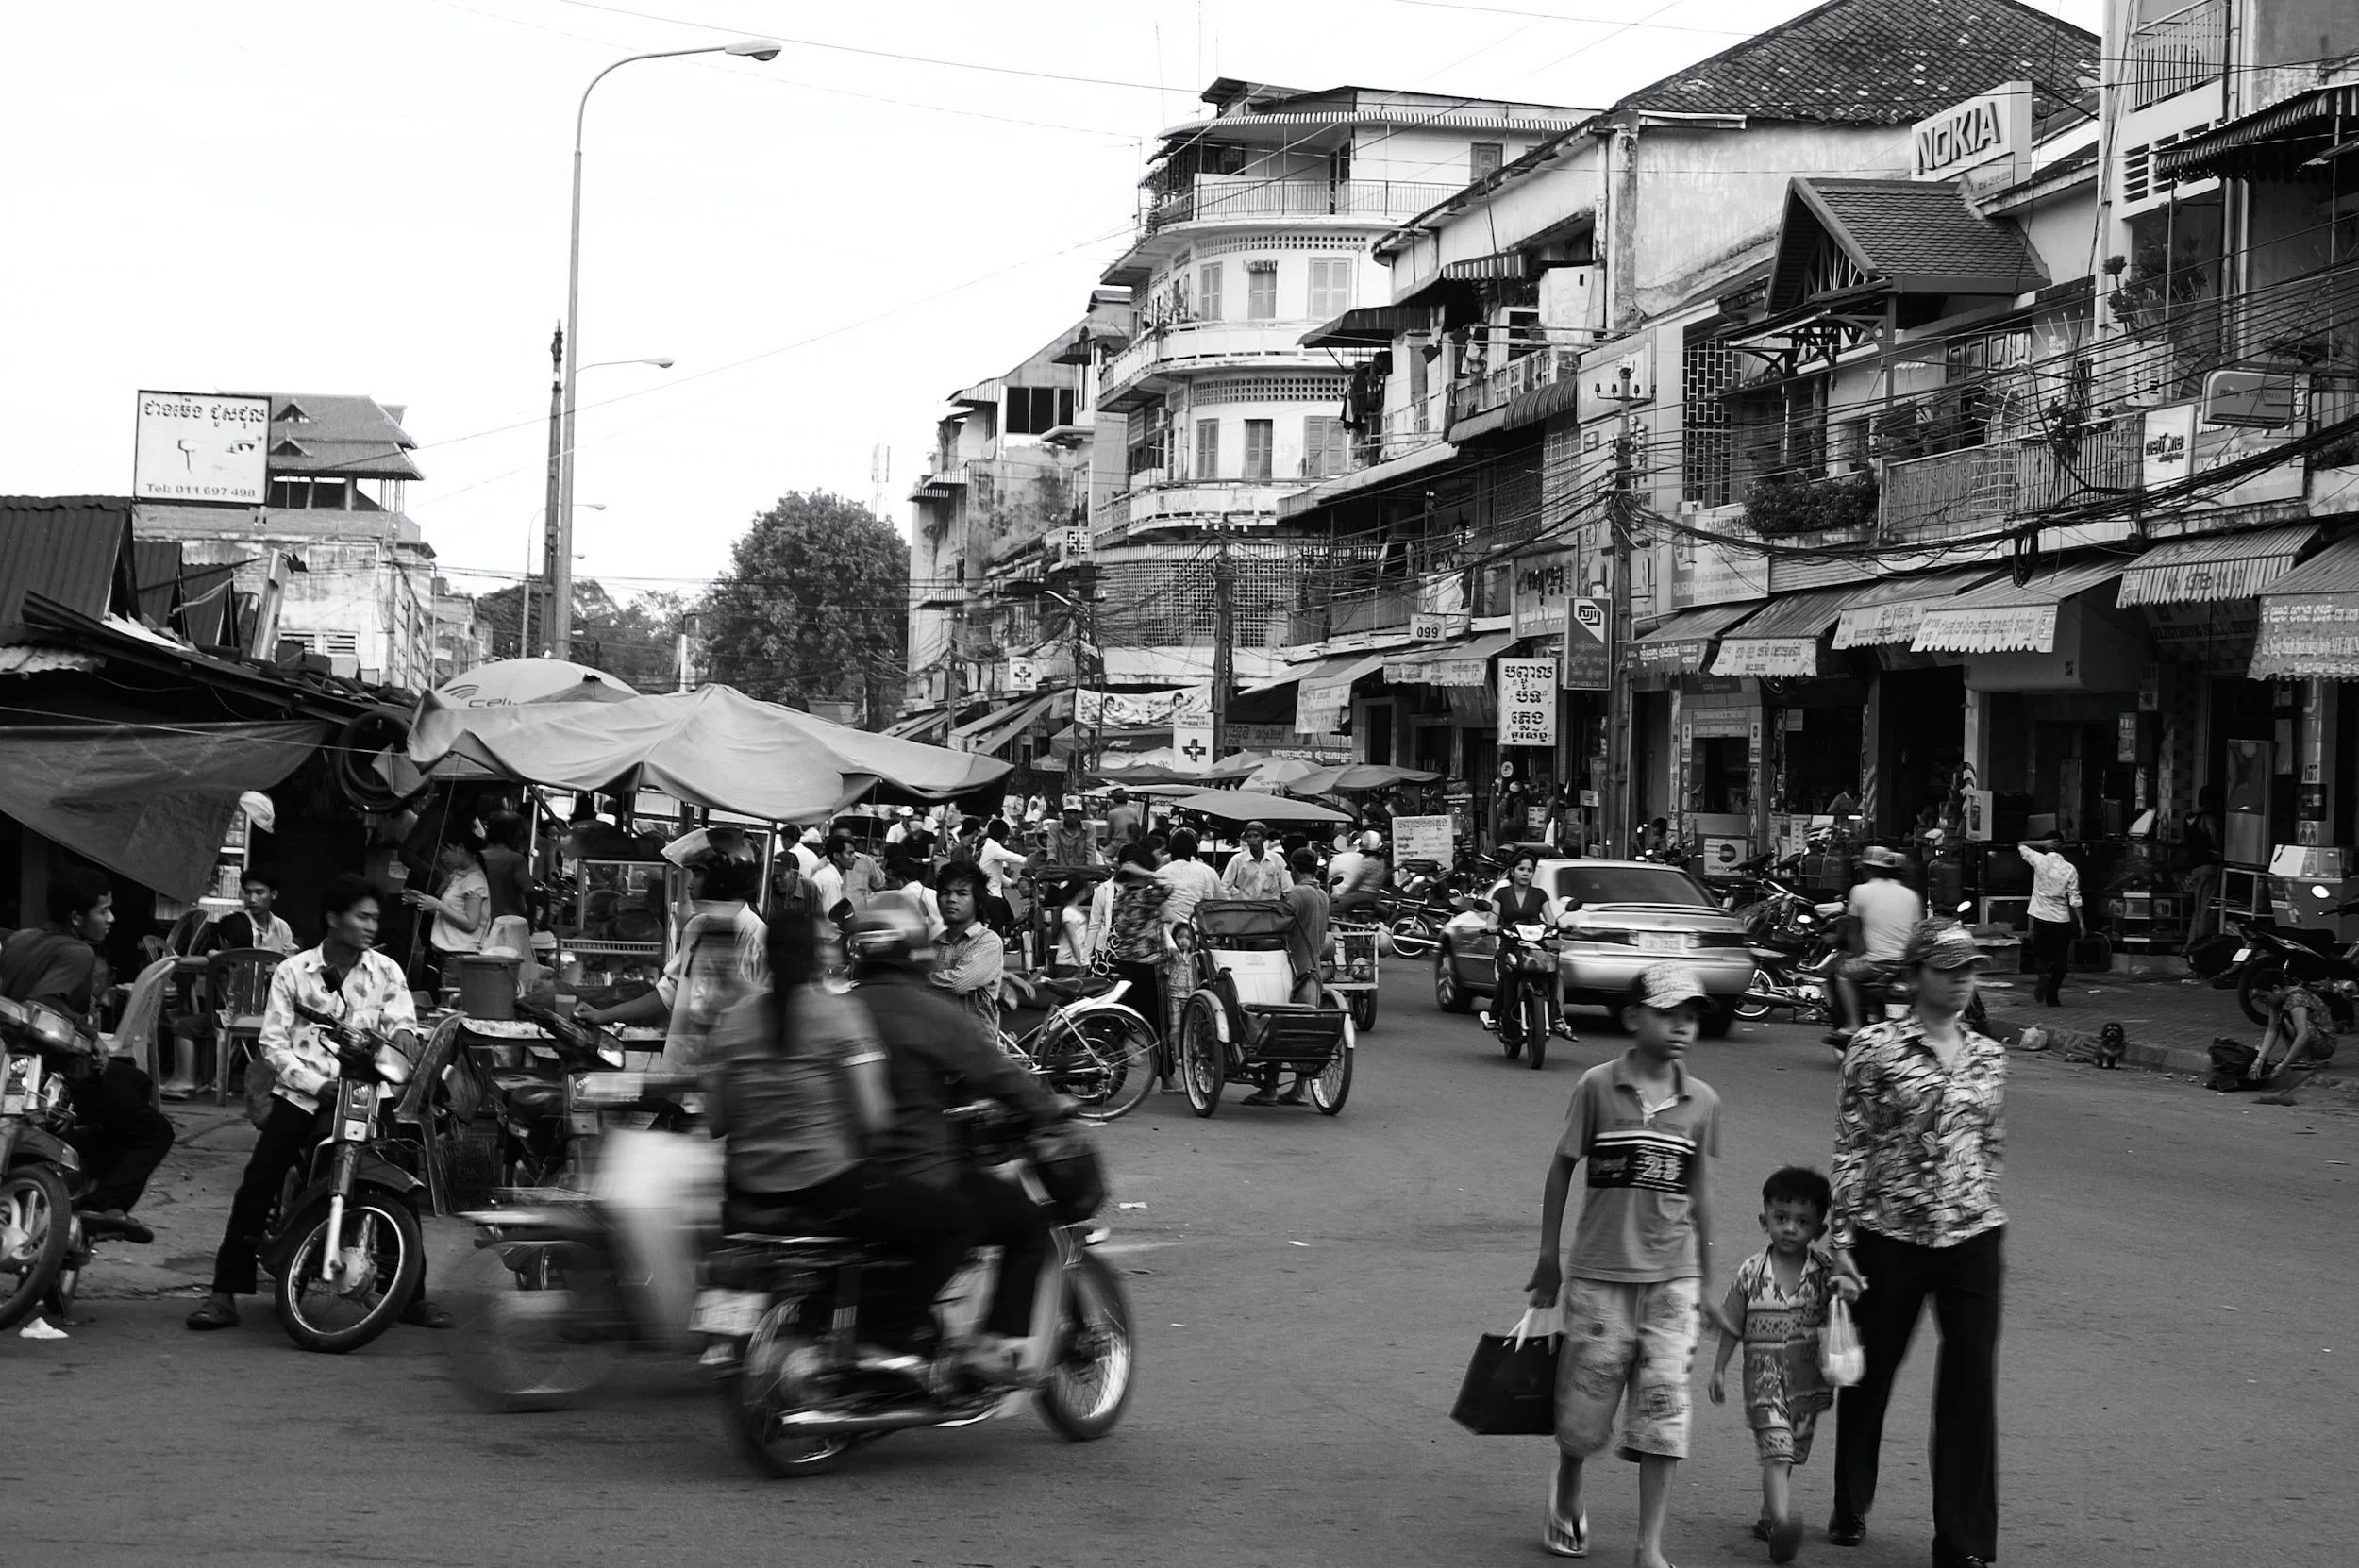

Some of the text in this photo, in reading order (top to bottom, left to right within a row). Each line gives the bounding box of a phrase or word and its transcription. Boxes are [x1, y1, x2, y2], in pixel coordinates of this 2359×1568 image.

[1916, 101, 2001, 176] NOKIA
[146, 482, 256, 497] Tel: 011 697 498
[1578, 605, 1601, 626] FUJI
[1416, 626, 1439, 639] 099
[1516, 690, 1541, 703] បទ
[1511, 711, 1544, 731] ភ្លេង
